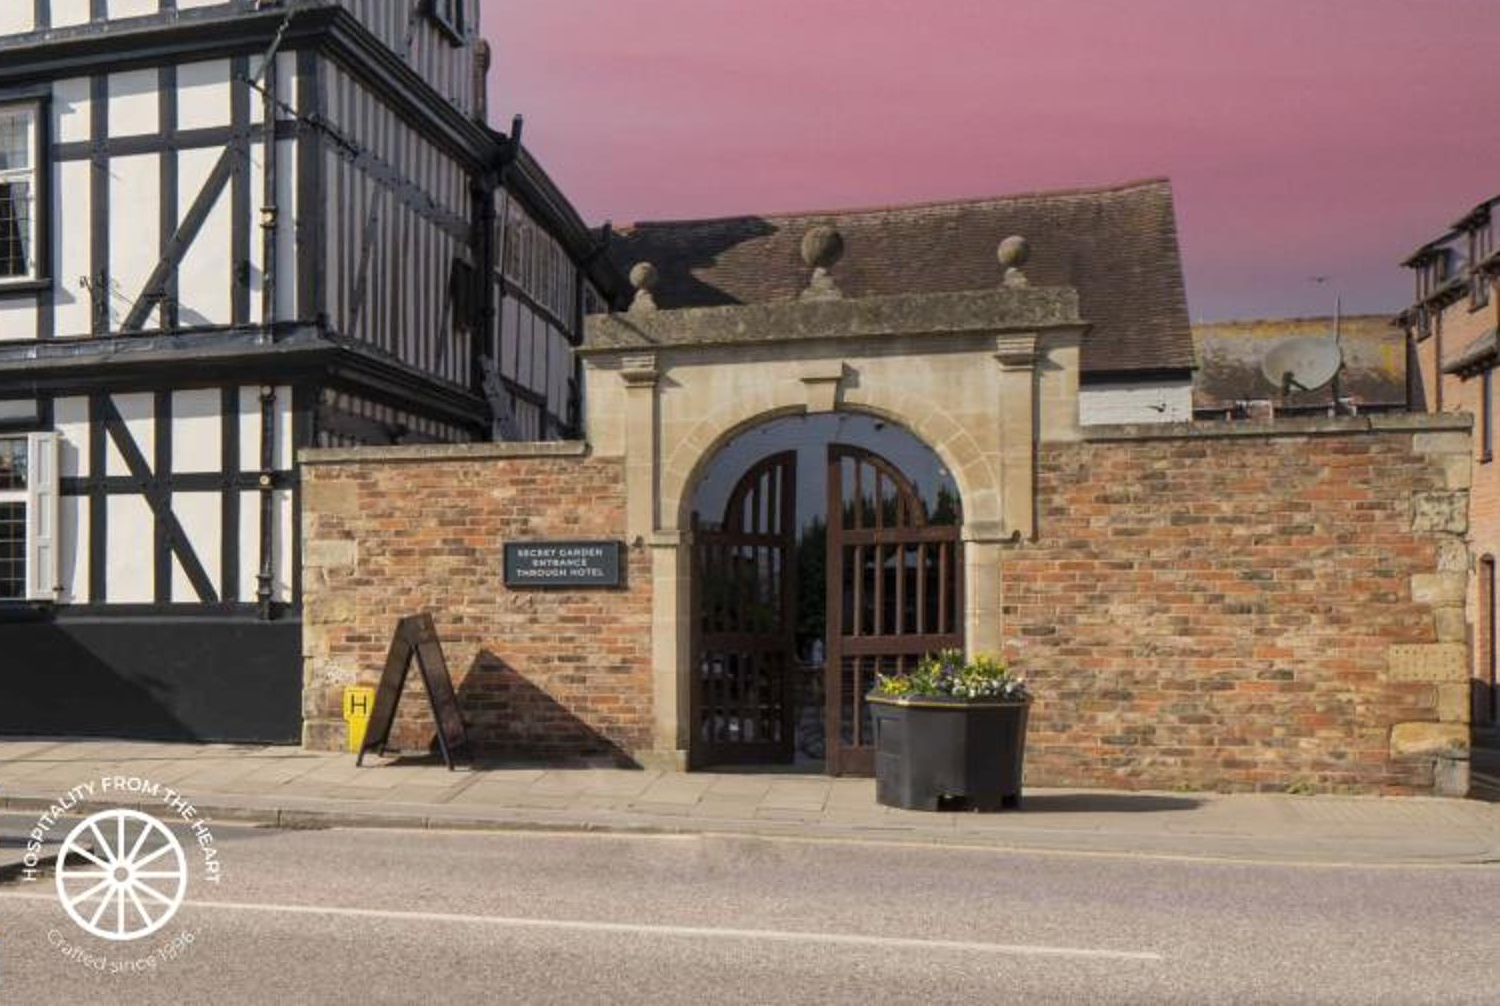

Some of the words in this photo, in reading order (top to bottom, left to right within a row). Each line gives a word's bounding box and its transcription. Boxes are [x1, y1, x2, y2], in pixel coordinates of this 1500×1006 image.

[517, 549, 556, 557] SECRET
[560, 548, 603, 557] GARDEN
[532, 559, 587, 567] ENTRANCE
[516, 569, 566, 577] THROUGH
[570, 568, 604, 577] HOTEL
[352, 695, 367, 714] H
